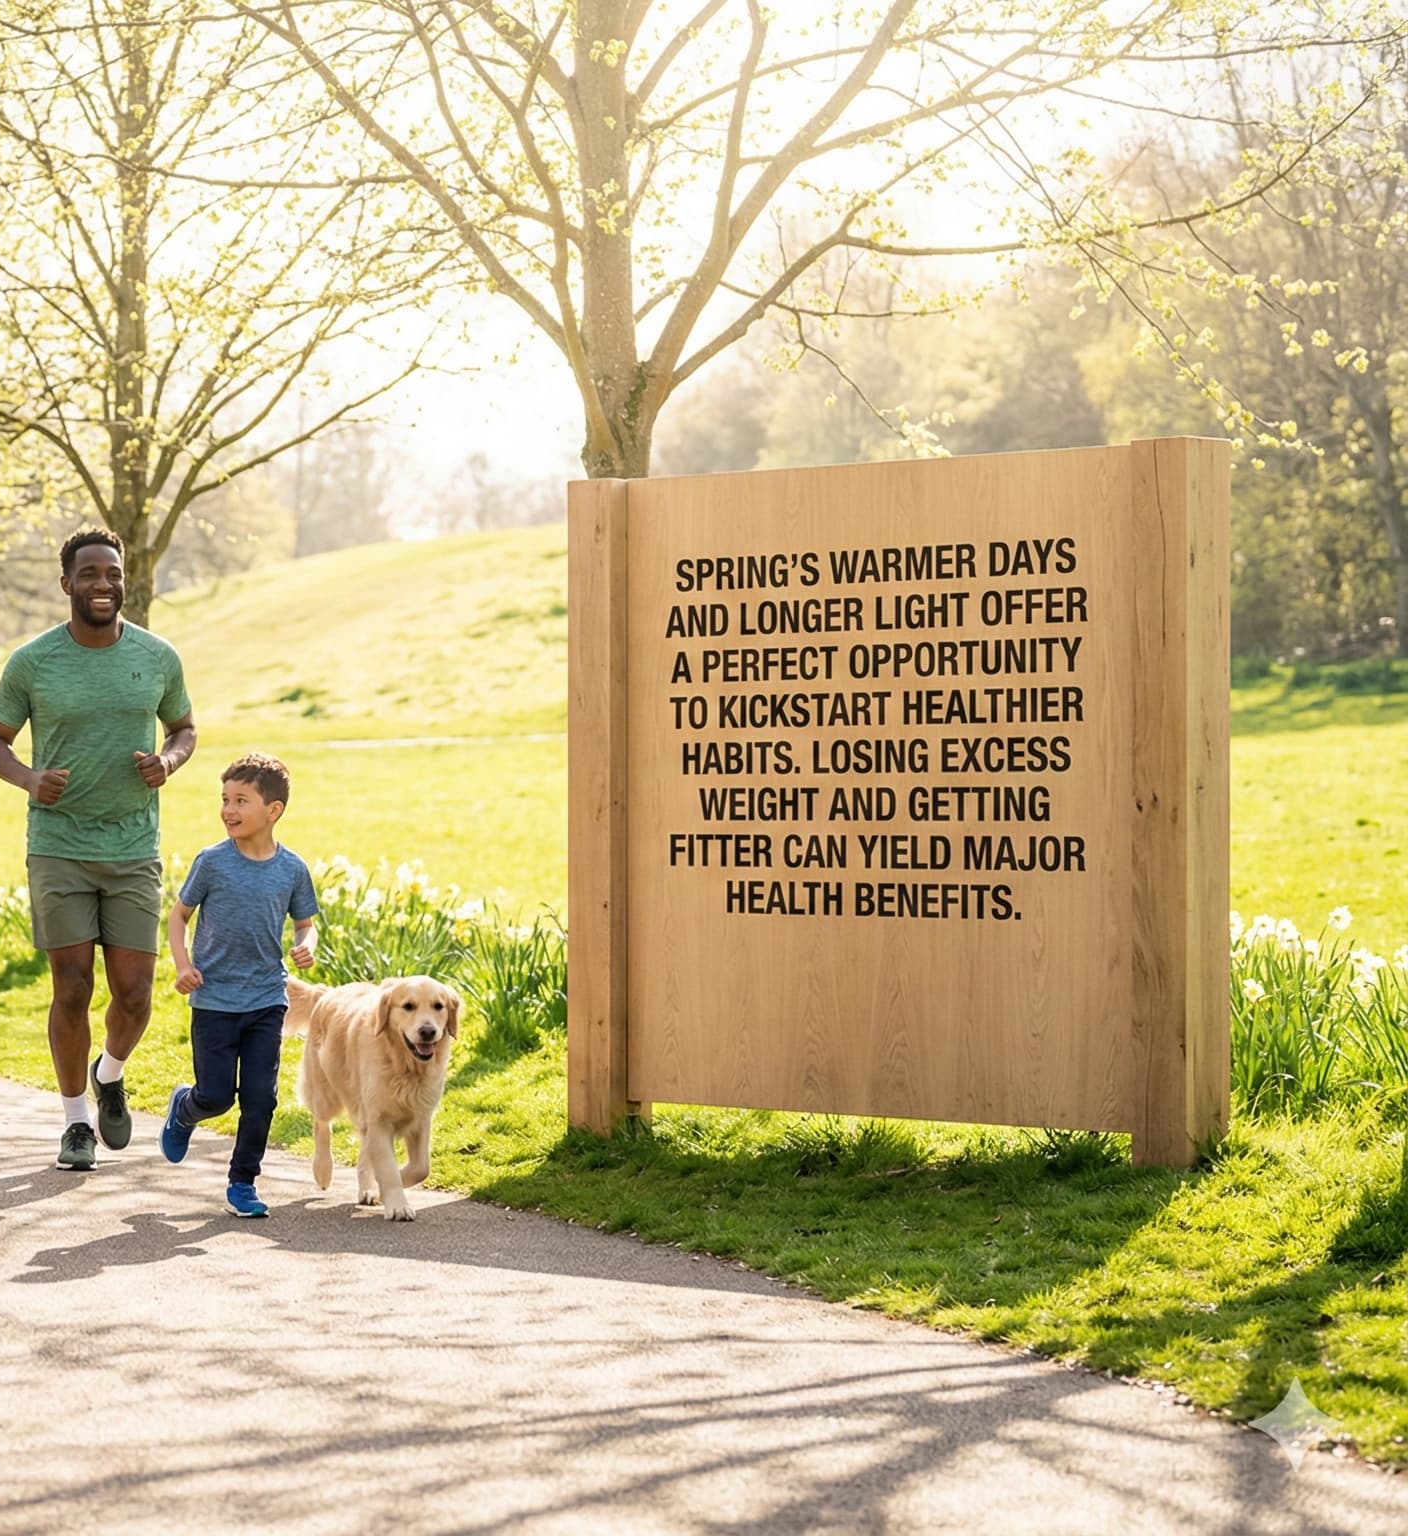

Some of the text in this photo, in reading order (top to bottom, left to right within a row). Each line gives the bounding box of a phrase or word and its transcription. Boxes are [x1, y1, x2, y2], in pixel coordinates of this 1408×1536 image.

[676, 538, 1076, 592] SPRING’S WARMER DAYS
[666, 587, 1088, 638] AND LONGER LIGHT OFFER
[671, 637, 1082, 683] A PERFECT OPPORTUNITY
[670, 687, 1083, 729] TO KICKSTART HEALTHIER
[683, 736, 1071, 775] HABITS. LOSING EXCESS
[699, 786, 1050, 821] WEIGHT AND GETTING
[670, 834, 1086, 871] FITTER CAN YIELD MAJOR
[727, 881, 1021, 920] HEALTH BENEFITS.
